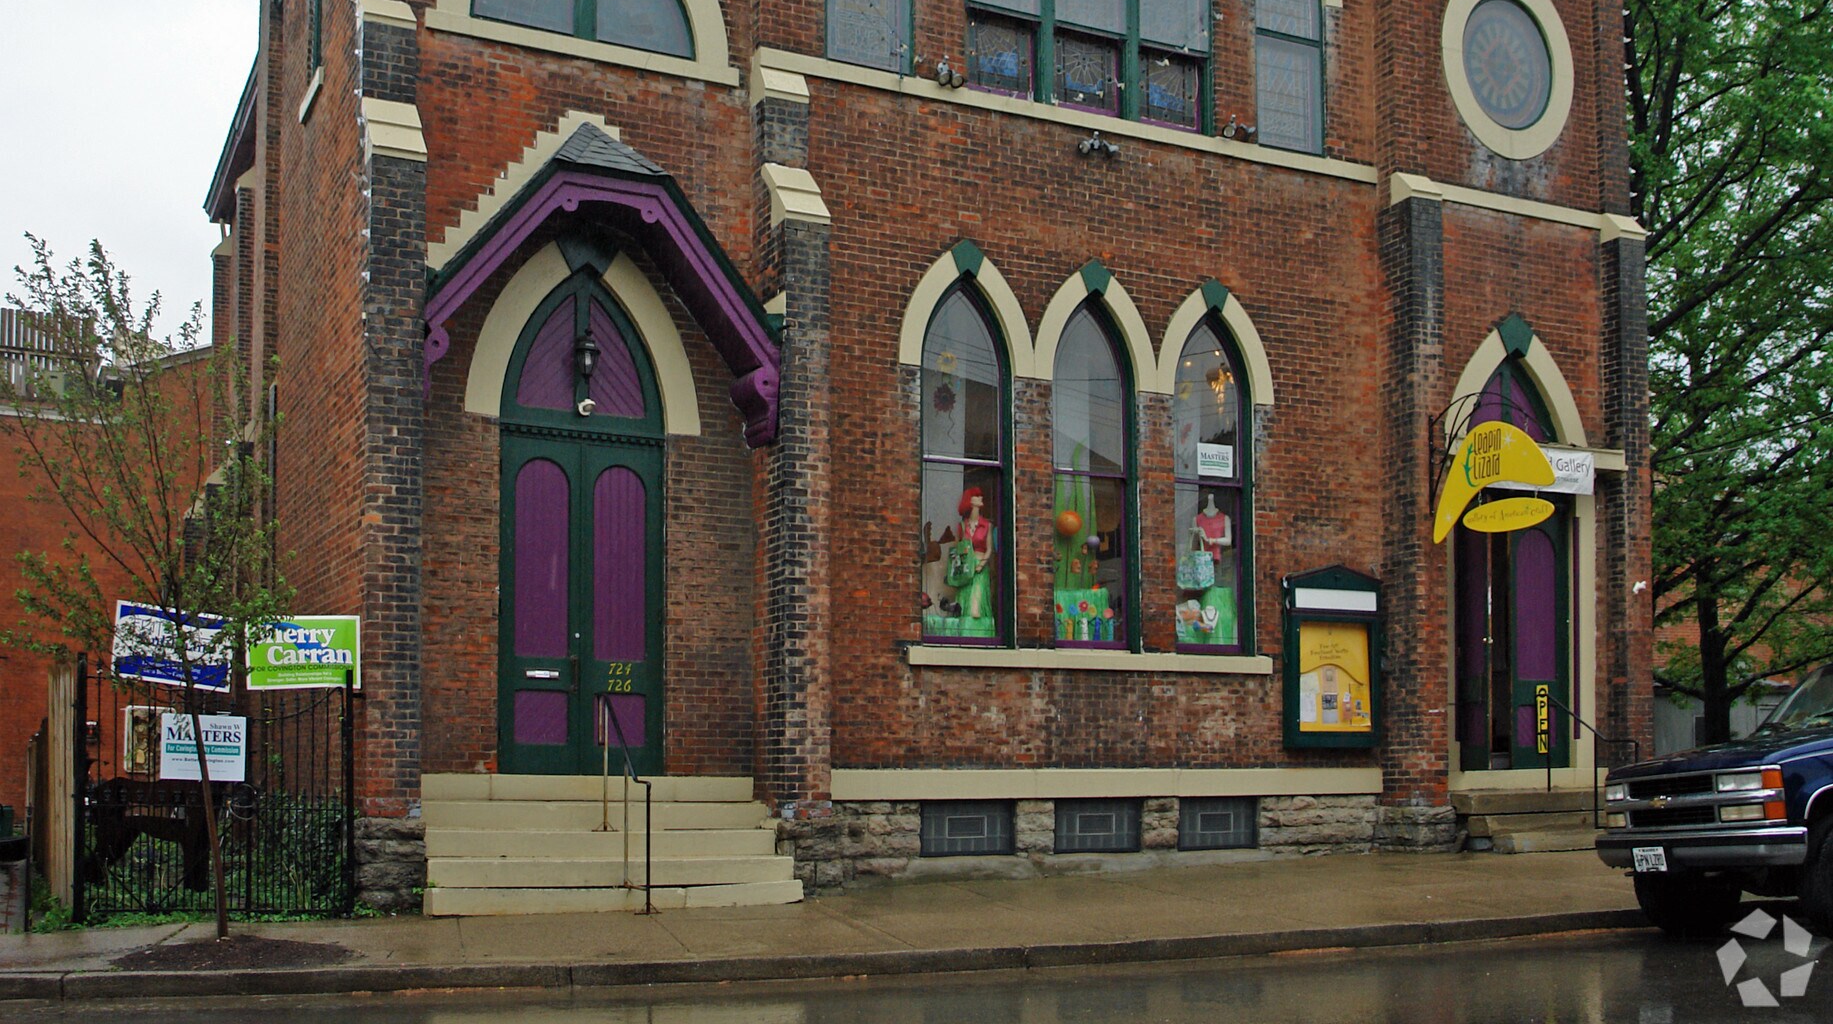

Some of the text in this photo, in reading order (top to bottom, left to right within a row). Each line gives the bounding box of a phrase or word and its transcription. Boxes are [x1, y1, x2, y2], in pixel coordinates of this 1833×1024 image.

[1200, 452, 1230, 462] MASTERS
[1556, 457, 1591, 477] Gallery
[266, 645, 353, 666] Carran
[267, 664, 307, 673] COVINGTON
[608, 663, 632, 676] 724
[608, 679, 631, 692] 726
[1538, 687, 1548, 752] OPEN
[209, 723, 232, 731] Shawn
[166, 727, 242, 744] MATERS
